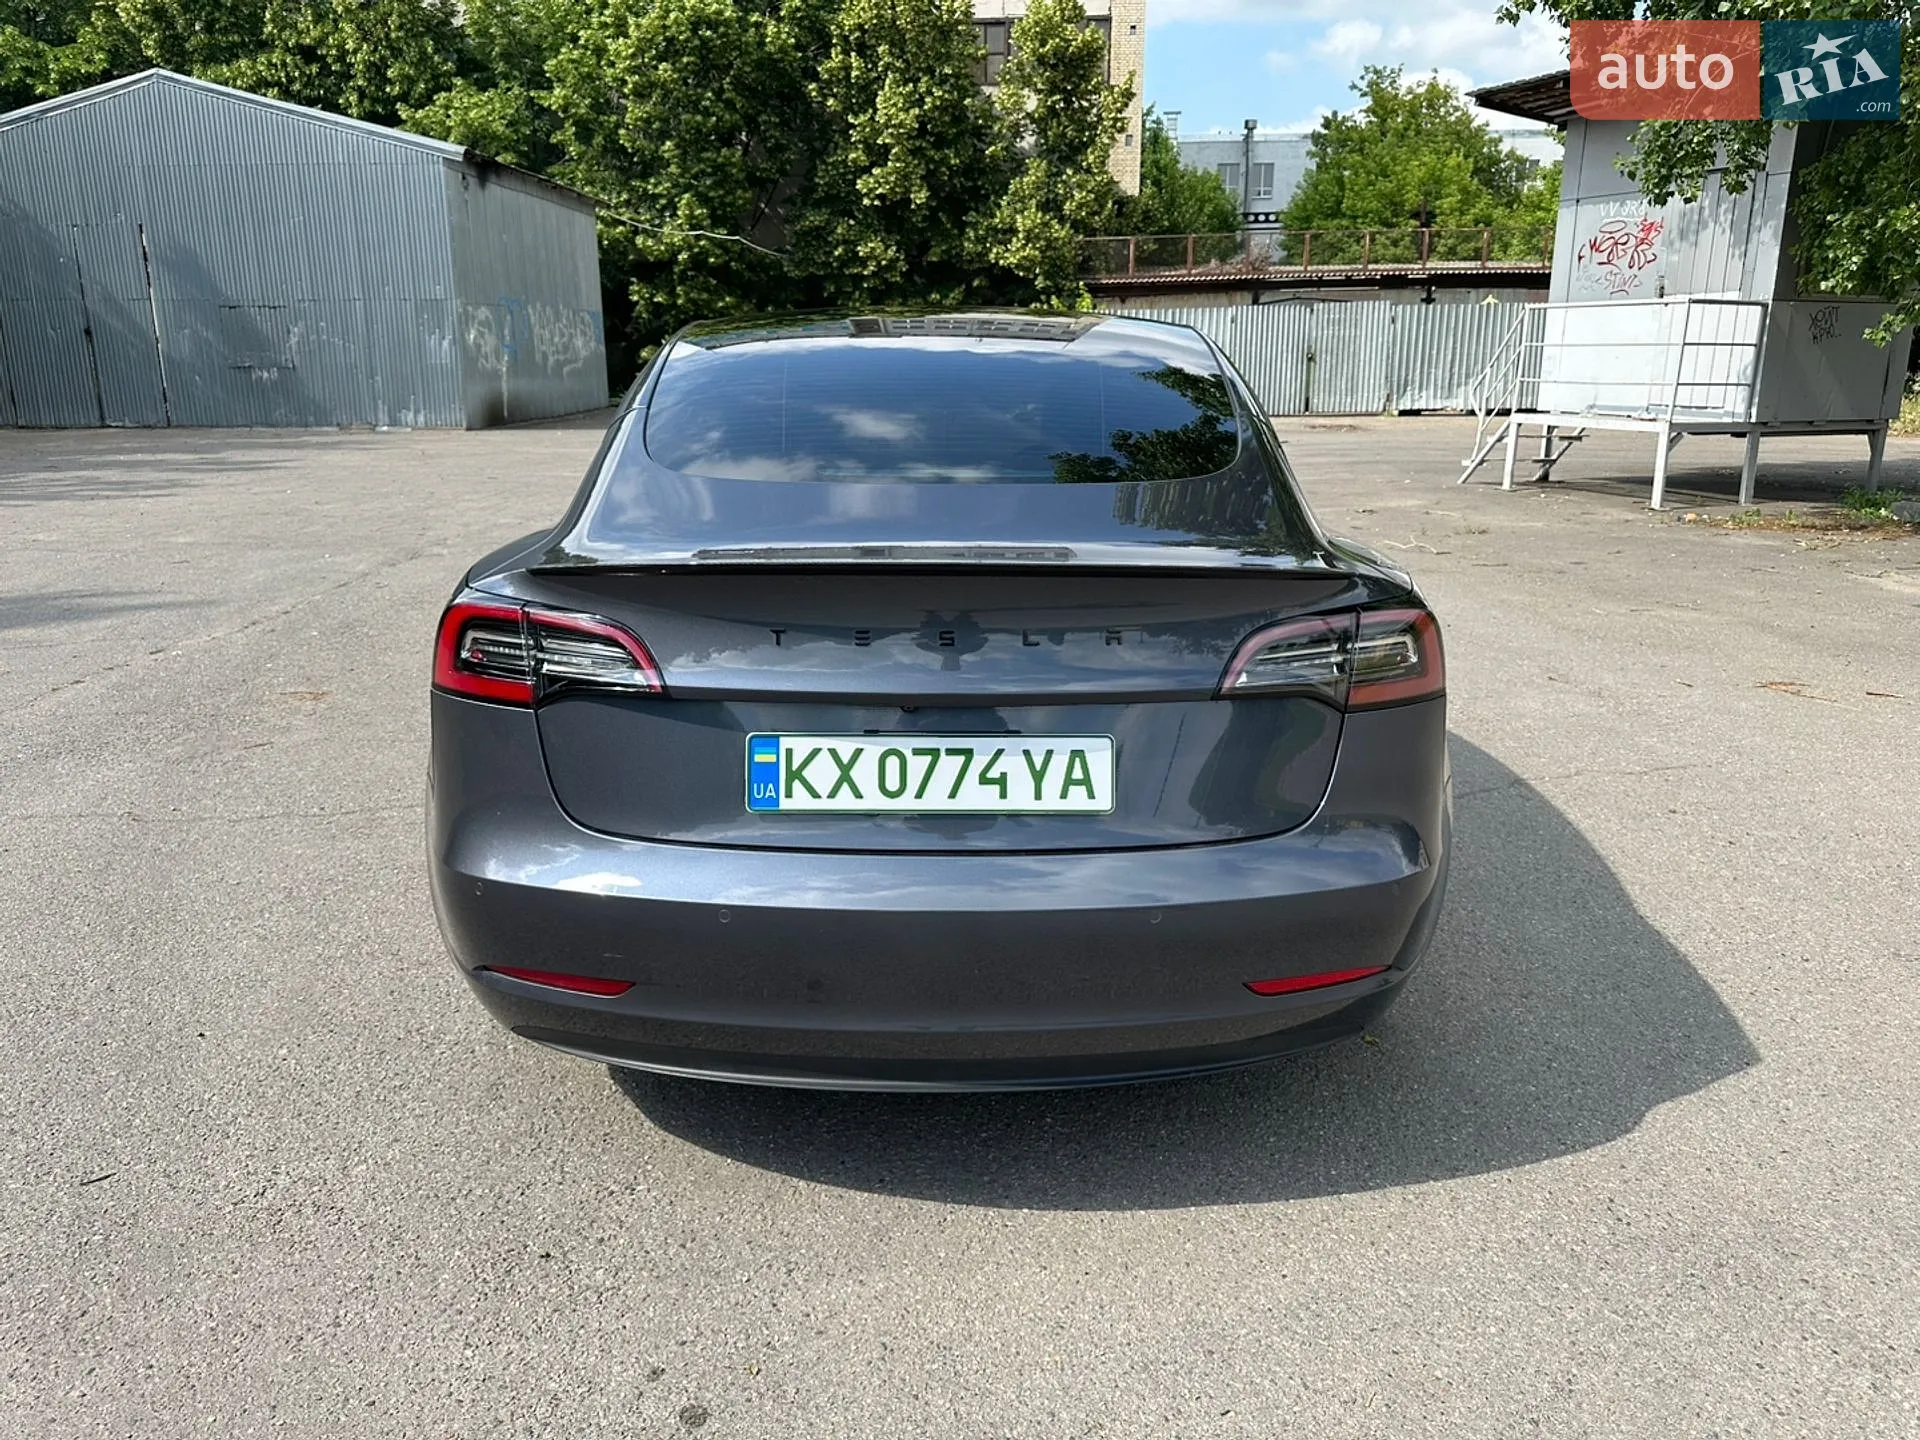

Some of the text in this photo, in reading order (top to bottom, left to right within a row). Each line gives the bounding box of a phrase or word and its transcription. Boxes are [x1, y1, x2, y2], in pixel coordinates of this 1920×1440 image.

[769, 628, 1123, 648] TESLA
[784, 747, 1096, 801] KX 0774 YA
[753, 783, 776, 799] UA
